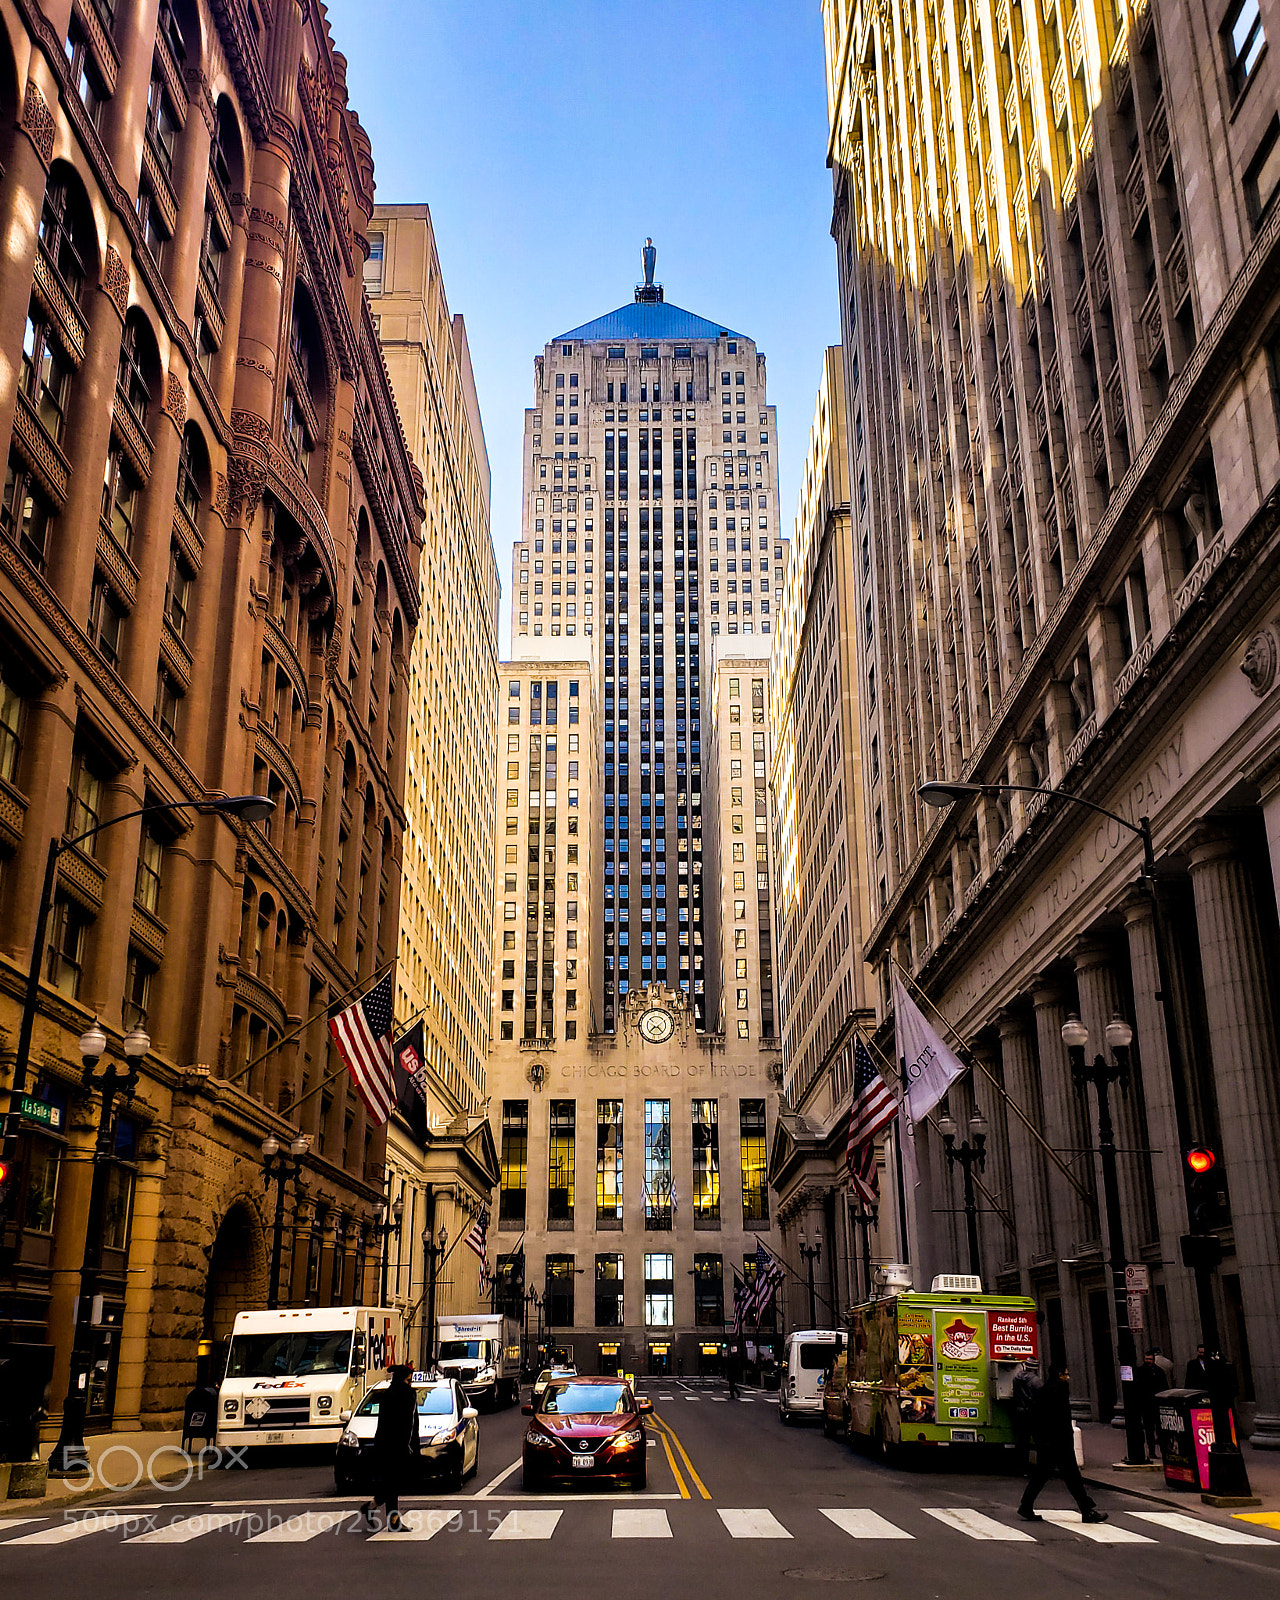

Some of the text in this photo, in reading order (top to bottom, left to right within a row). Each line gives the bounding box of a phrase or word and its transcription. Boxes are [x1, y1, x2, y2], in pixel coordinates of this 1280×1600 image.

[1012, 905, 1036, 957] AND
[1043, 847, 1085, 919] TRUST
[1094, 729, 1185, 863] COMPANY
[561, 1064, 757, 1078] CHICAGO BOARD OF TRADE
[992, 1323, 1033, 1332] Best Burrito
[996, 1333, 1031, 1342] in the U.S.
[367, 1316, 397, 1371] FedEx
[423, 1372, 435, 1381] TAXI
[252, 1380, 306, 1390] FedEx
